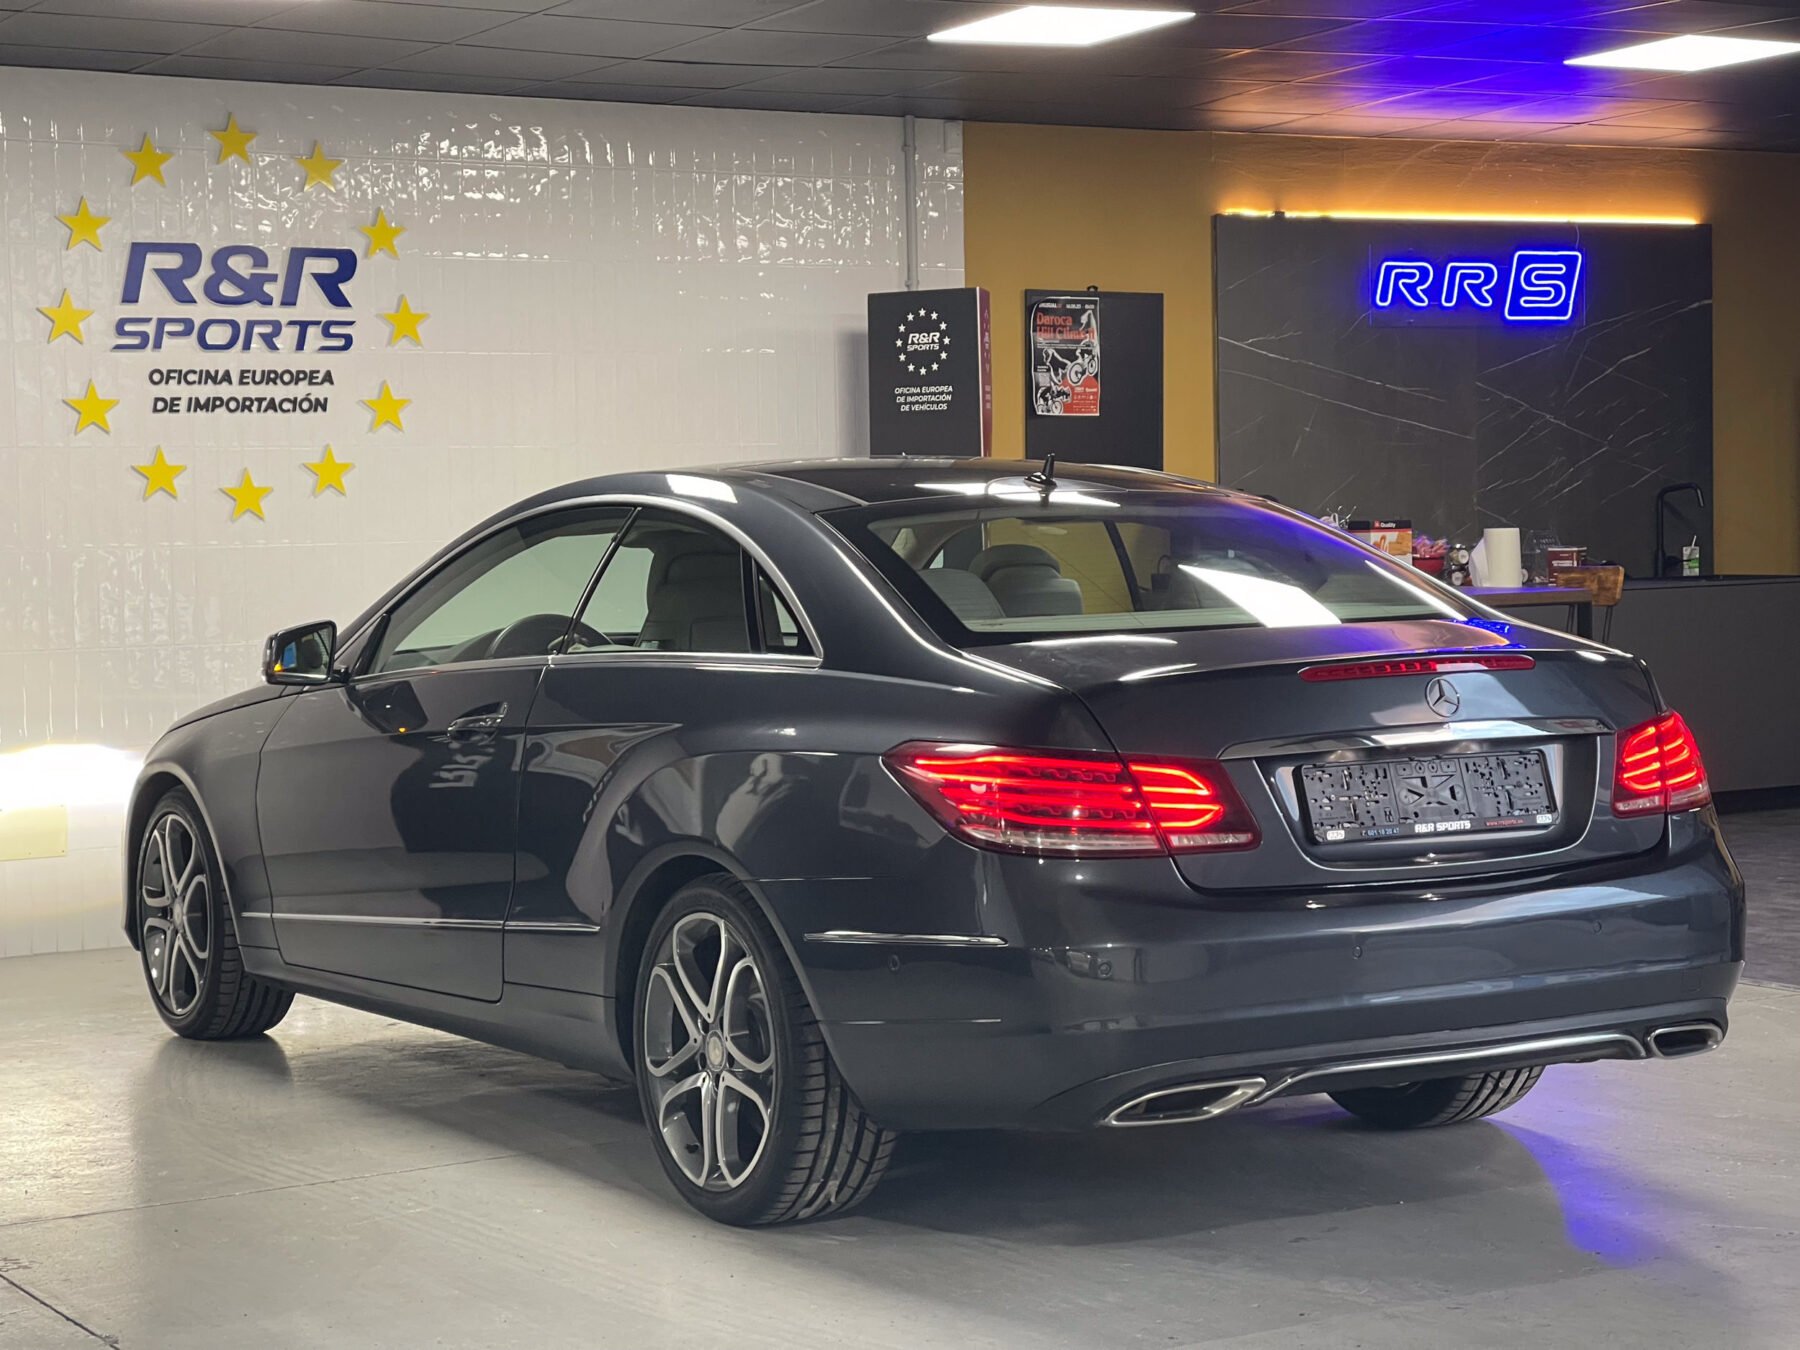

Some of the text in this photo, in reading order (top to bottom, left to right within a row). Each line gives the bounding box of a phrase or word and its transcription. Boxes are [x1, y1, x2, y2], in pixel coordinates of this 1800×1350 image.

[121, 242, 358, 307] R&R
[1037, 312, 1073, 326] Daroca
[111, 317, 357, 351] SPORTS
[908, 332, 940, 344] R&R
[907, 343, 940, 352] SPORTS
[148, 369, 334, 386] OFICINA EUROPEA
[921, 385, 953, 393] EUROPEA
[152, 393, 328, 413] DE IMPORTACIÓN
[907, 394, 952, 402] IMPORTACIÓN
[911, 402, 948, 411] VEHÍCULOS
[1414, 823, 1435, 834] R&R
[1436, 820, 1471, 832] SPORTS
